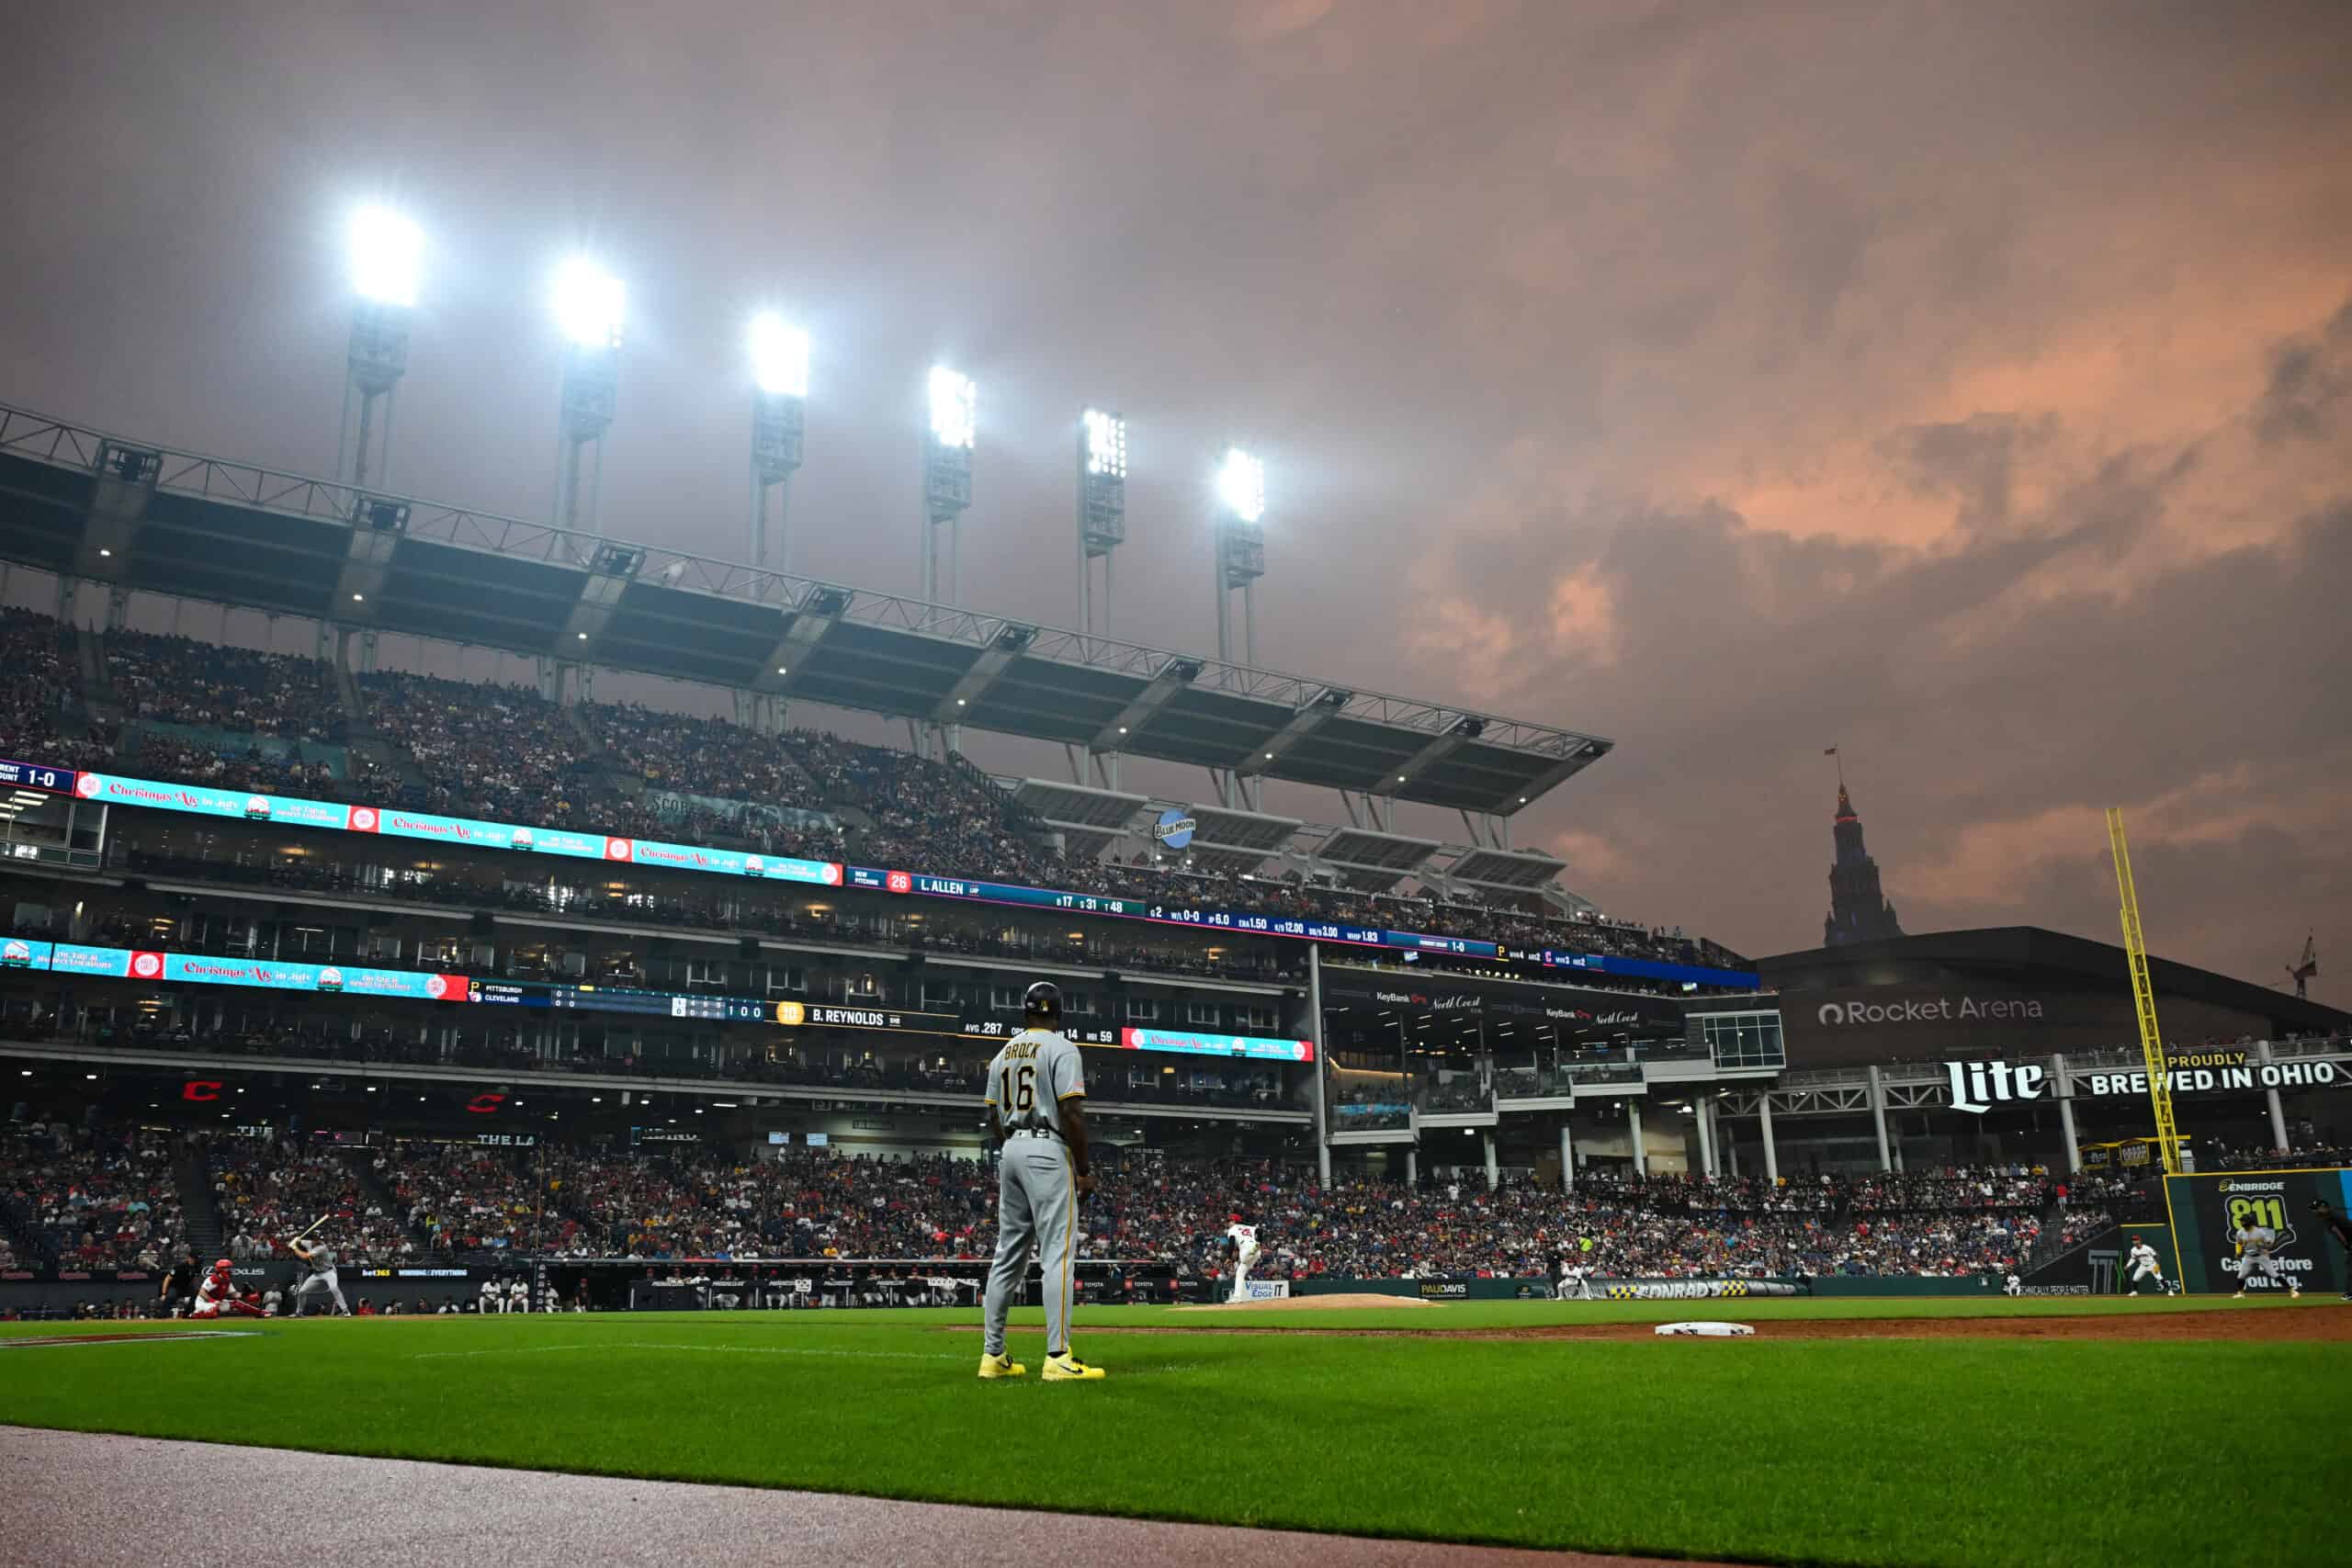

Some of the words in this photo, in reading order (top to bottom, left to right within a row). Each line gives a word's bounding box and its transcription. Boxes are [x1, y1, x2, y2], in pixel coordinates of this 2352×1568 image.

[28, 770, 55, 787] 1-0
[109, 783, 172, 802] Christmas
[392, 818, 447, 834] Christmas
[891, 875, 907, 889] 26
[921, 879, 930, 891] L.
[932, 881, 964, 895] ALLEN
[1063, 896, 1073, 908] 17
[1086, 898, 1097, 909] 31
[1110, 902, 1122, 913] 48
[1156, 906, 1162, 917] 2
[1184, 910, 1200, 922] 0-0
[1216, 914, 1230, 925] 6.0
[1250, 917, 1267, 930] 1.50
[1285, 921, 1304, 934] 12.00
[1323, 926, 1338, 938] 3.00
[1362, 931, 1378, 942] 1.83
[1452, 941, 1465, 952] 1-0
[1498, 945, 1505, 957] P
[184, 962, 245, 977] Christmas
[485, 994, 520, 1003] CLEVELAND
[1377, 992, 1410, 1003] KeyBank
[729, 1006, 733, 1015] 1
[741, 1006, 748, 1016] 0
[753, 1007, 761, 1017] 0
[813, 1009, 824, 1022] B.
[826, 1010, 884, 1026] REYNOLDS
[1546, 1008, 1576, 1019] KeyBank
[1847, 998, 1953, 1024] Rocket
[1959, 997, 2043, 1020] Arena
[965, 1024, 979, 1033] AVG
[981, 1022, 1003, 1035] .287
[1068, 1028, 1079, 1040] 14
[1100, 1031, 1112, 1043] 59
[1005, 1043, 1042, 1060] BROCK
[2167, 1053, 2245, 1068] PROUDLY
[2091, 1069, 2214, 1095] BREWED
[2222, 1067, 2253, 1089] IN
[2261, 1062, 2335, 1086] OHIO
[1001, 1065, 1035, 1112] 16
[1942, 1061, 2043, 1114] Lite
[477, 1134, 511, 1145] THE
[2229, 1182, 2286, 1191] ENBRIDGE
[2229, 1199, 2284, 1231] 811
[2258, 1257, 2313, 1271] efore
[1274, 1284, 1283, 1297] IT
[1441, 1284, 1466, 1294] DAVIS
